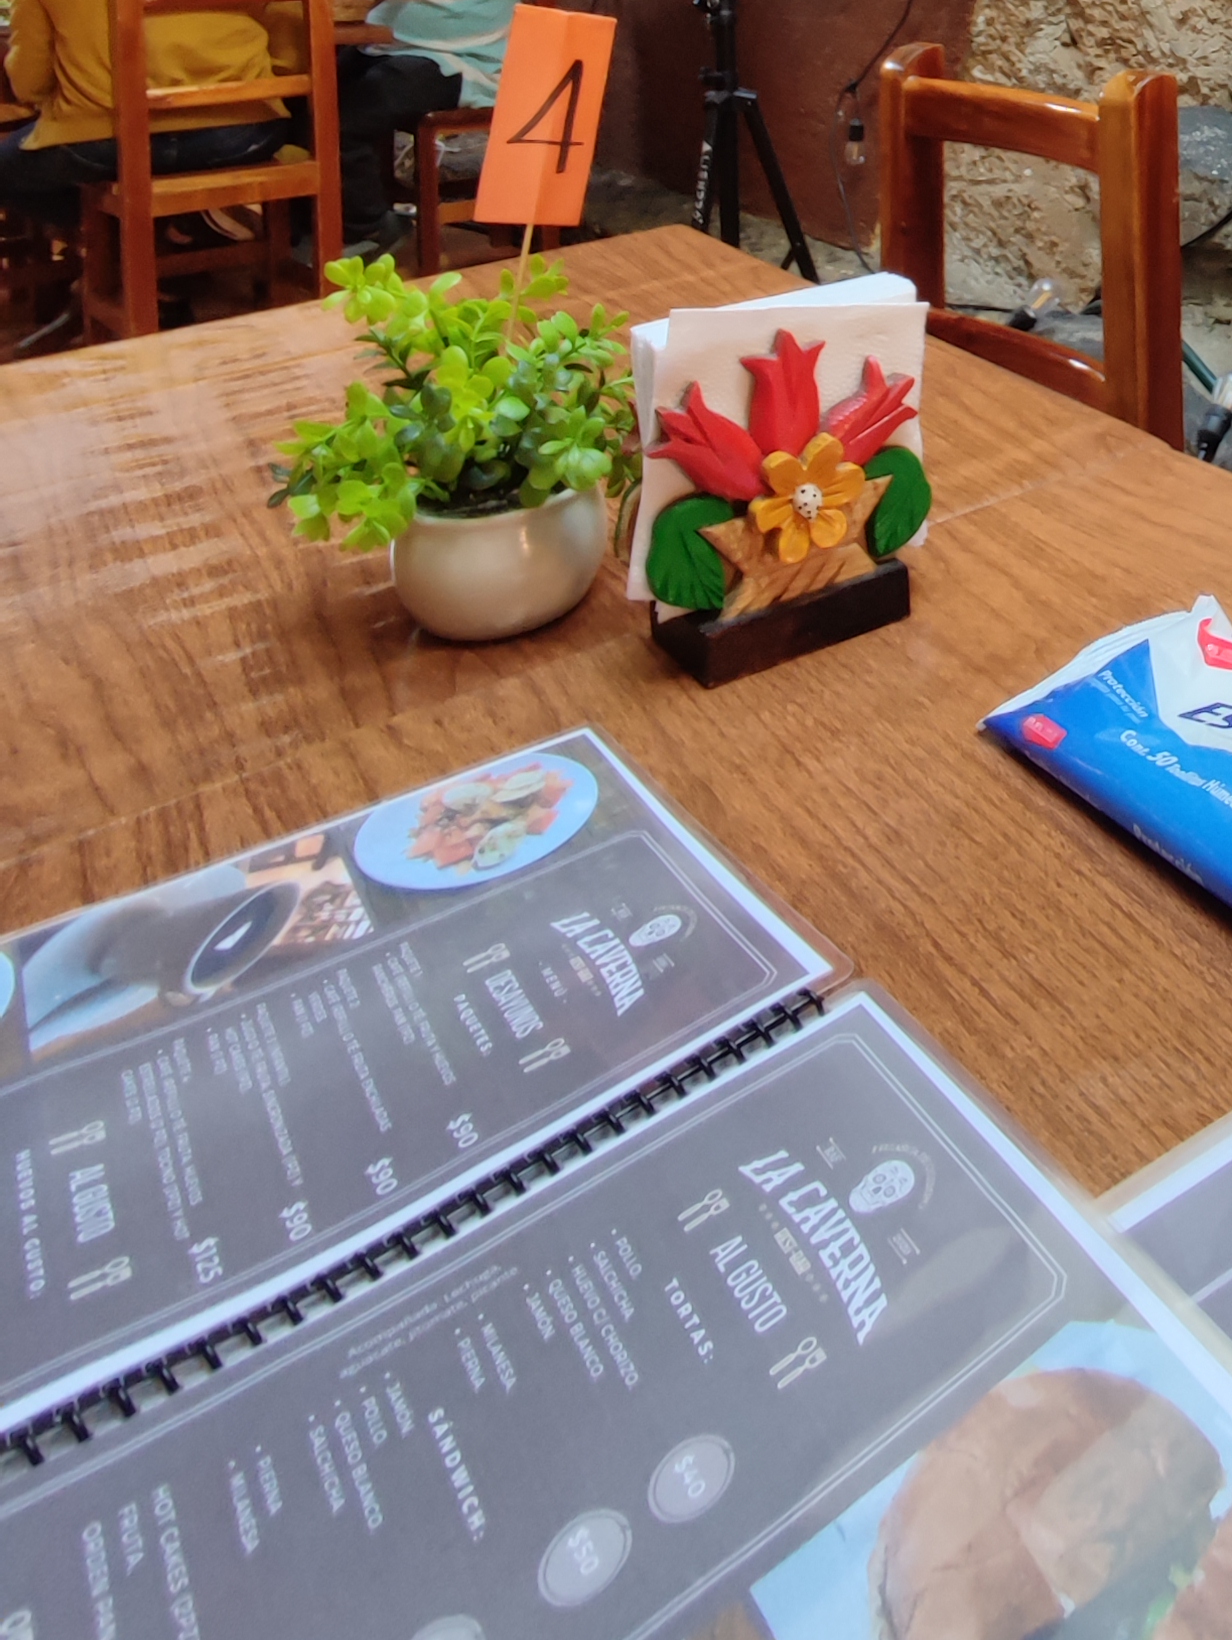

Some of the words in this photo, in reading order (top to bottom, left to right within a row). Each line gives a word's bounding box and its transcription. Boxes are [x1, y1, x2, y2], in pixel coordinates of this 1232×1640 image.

[506, 60, 584, 174] 4
[1146, 745, 1179, 769] 50
[550, 911, 601, 938] LA
[575, 928, 646, 1017] CAVERNA
[484, 968, 543, 1040] DESAYUNOS
[443, 1111, 480, 1149] $90
[15, 1148, 34, 1210] HUEVOS
[362, 1155, 399, 1196] $90
[22, 1213, 38, 1235] AL
[276, 1199, 314, 1242] $90
[187, 1235, 223, 1284] $125
[708, 1234, 749, 1273] AL
[737, 1148, 804, 1193] LA
[775, 1177, 889, 1345] CAVERNA
[545, 1278, 578, 1324] QUESO
[569, 1264, 601, 1311] HUEVO
[723, 1258, 789, 1335] GUSTO
[333, 1410, 364, 1466] QUESO
[673, 1453, 707, 1499] $40
[152, 1483, 175, 1525] HOT
[159, 1525, 189, 1593] CAKES
[565, 1527, 601, 1576] $50
